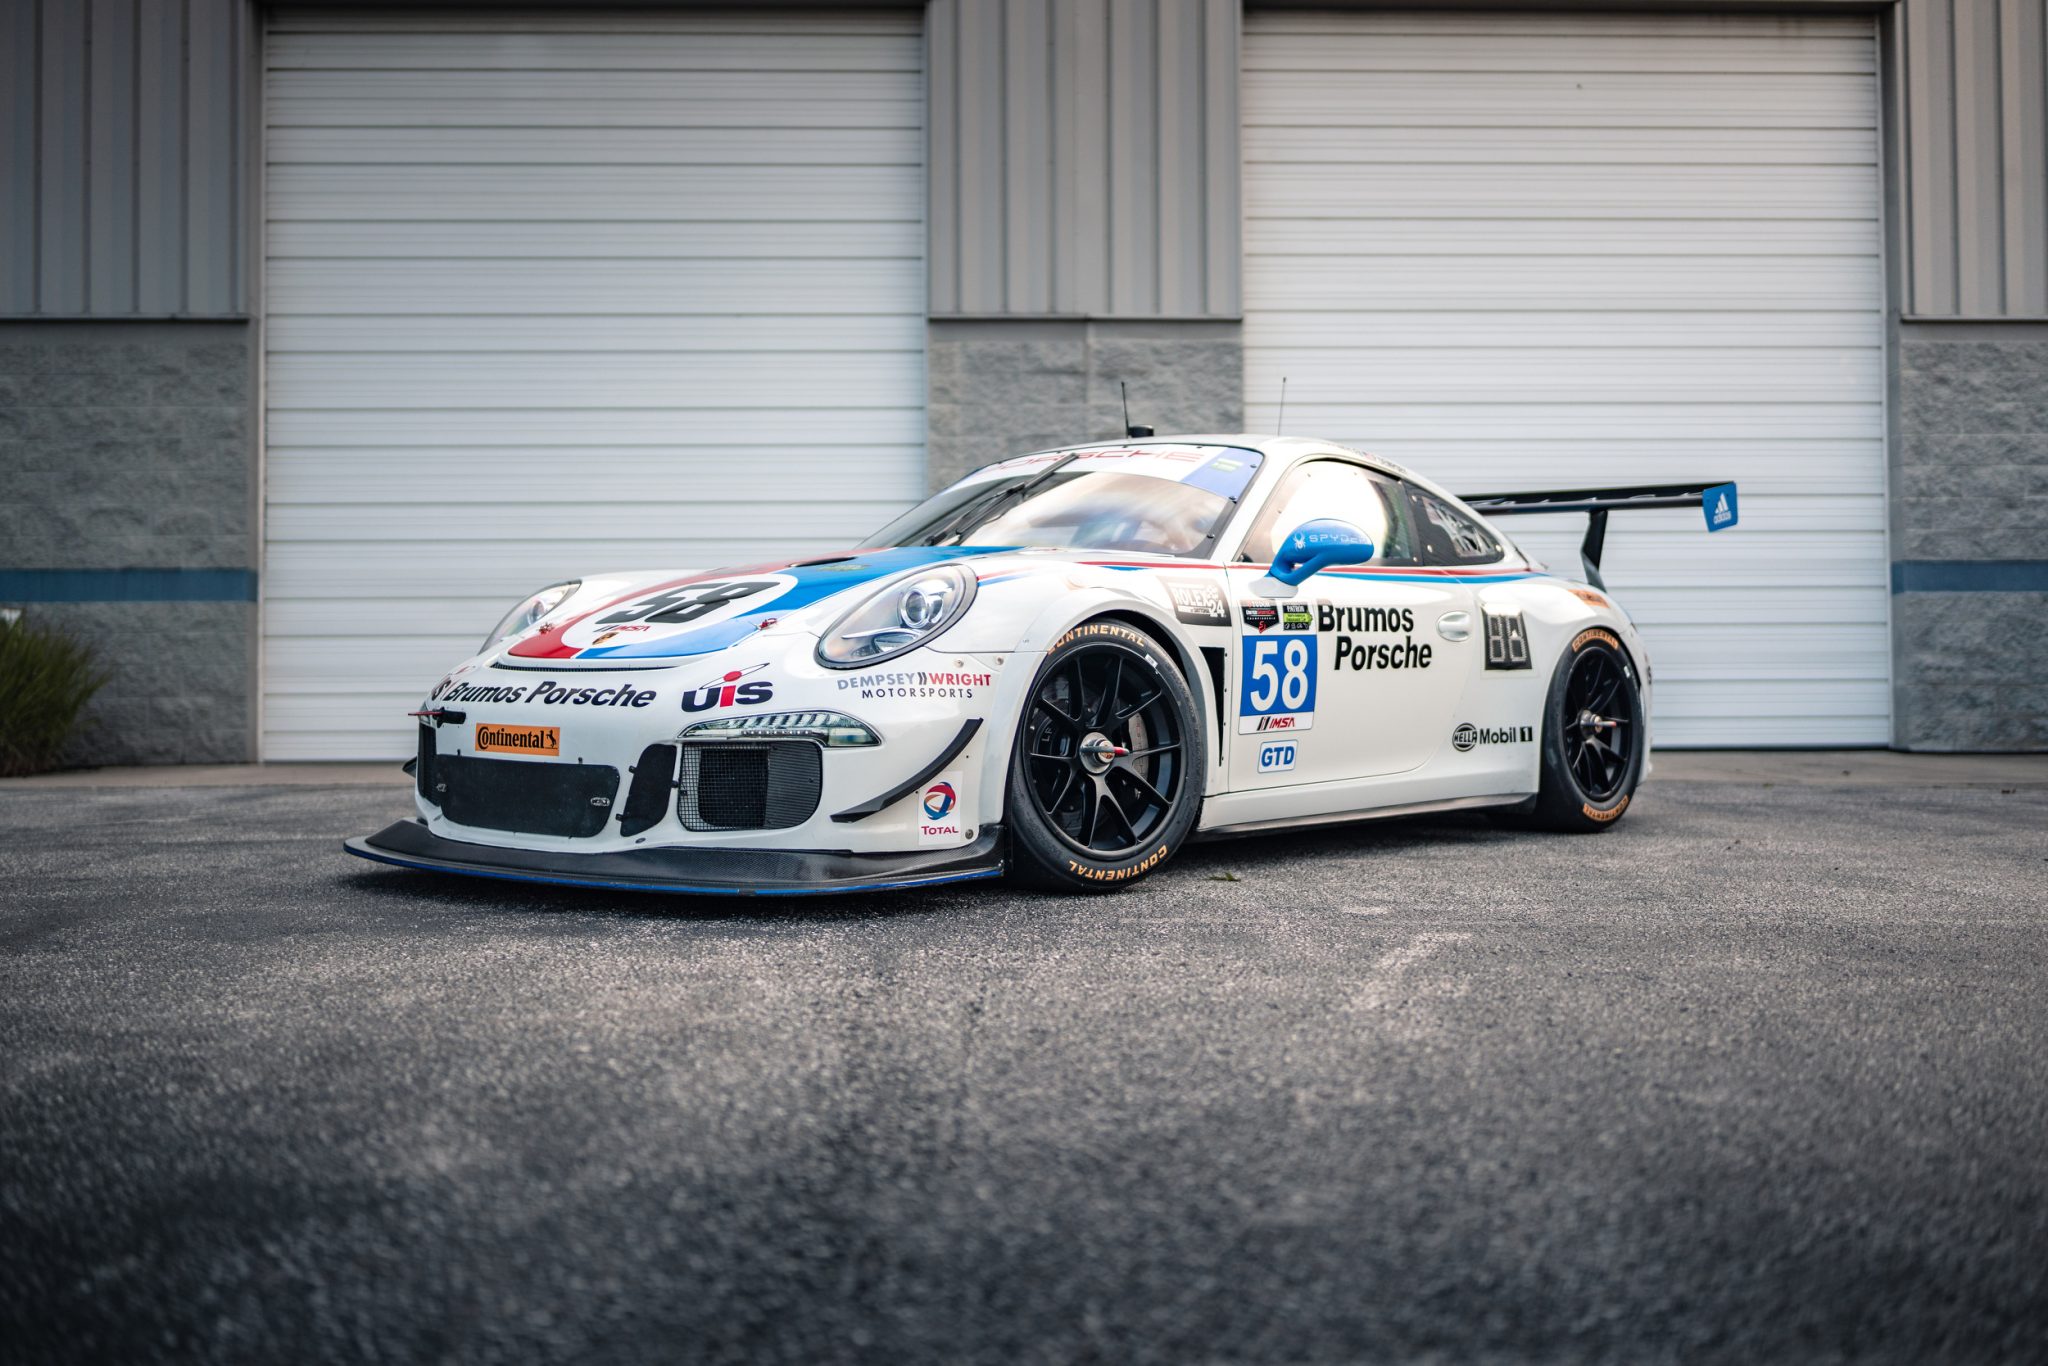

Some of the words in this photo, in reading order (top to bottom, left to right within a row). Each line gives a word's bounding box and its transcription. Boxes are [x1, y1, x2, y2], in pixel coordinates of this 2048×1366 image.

[595, 581, 780, 625] 58
[1209, 599, 1226, 618] 24
[1318, 600, 1414, 633] Brumos
[1334, 635, 1432, 671] Porsche
[837, 672, 916, 691] DEMPSEY
[929, 672, 992, 687] WRIGHT
[1250, 639, 1309, 712] 58
[443, 681, 528, 703] Brumos
[524, 681, 657, 708] Porsche
[862, 687, 973, 700] MOTORSPORTS
[1269, 717, 1296, 729] IMSA
[477, 726, 545, 751] Continental
[1454, 730, 1478, 743] HELLA
[1479, 726, 1517, 745] Mobil
[1520, 726, 1533, 743] 1
[1261, 745, 1295, 767] GTD
[921, 825, 959, 836] TOTAL
[1069, 845, 1168, 882] CONTINENTAL
